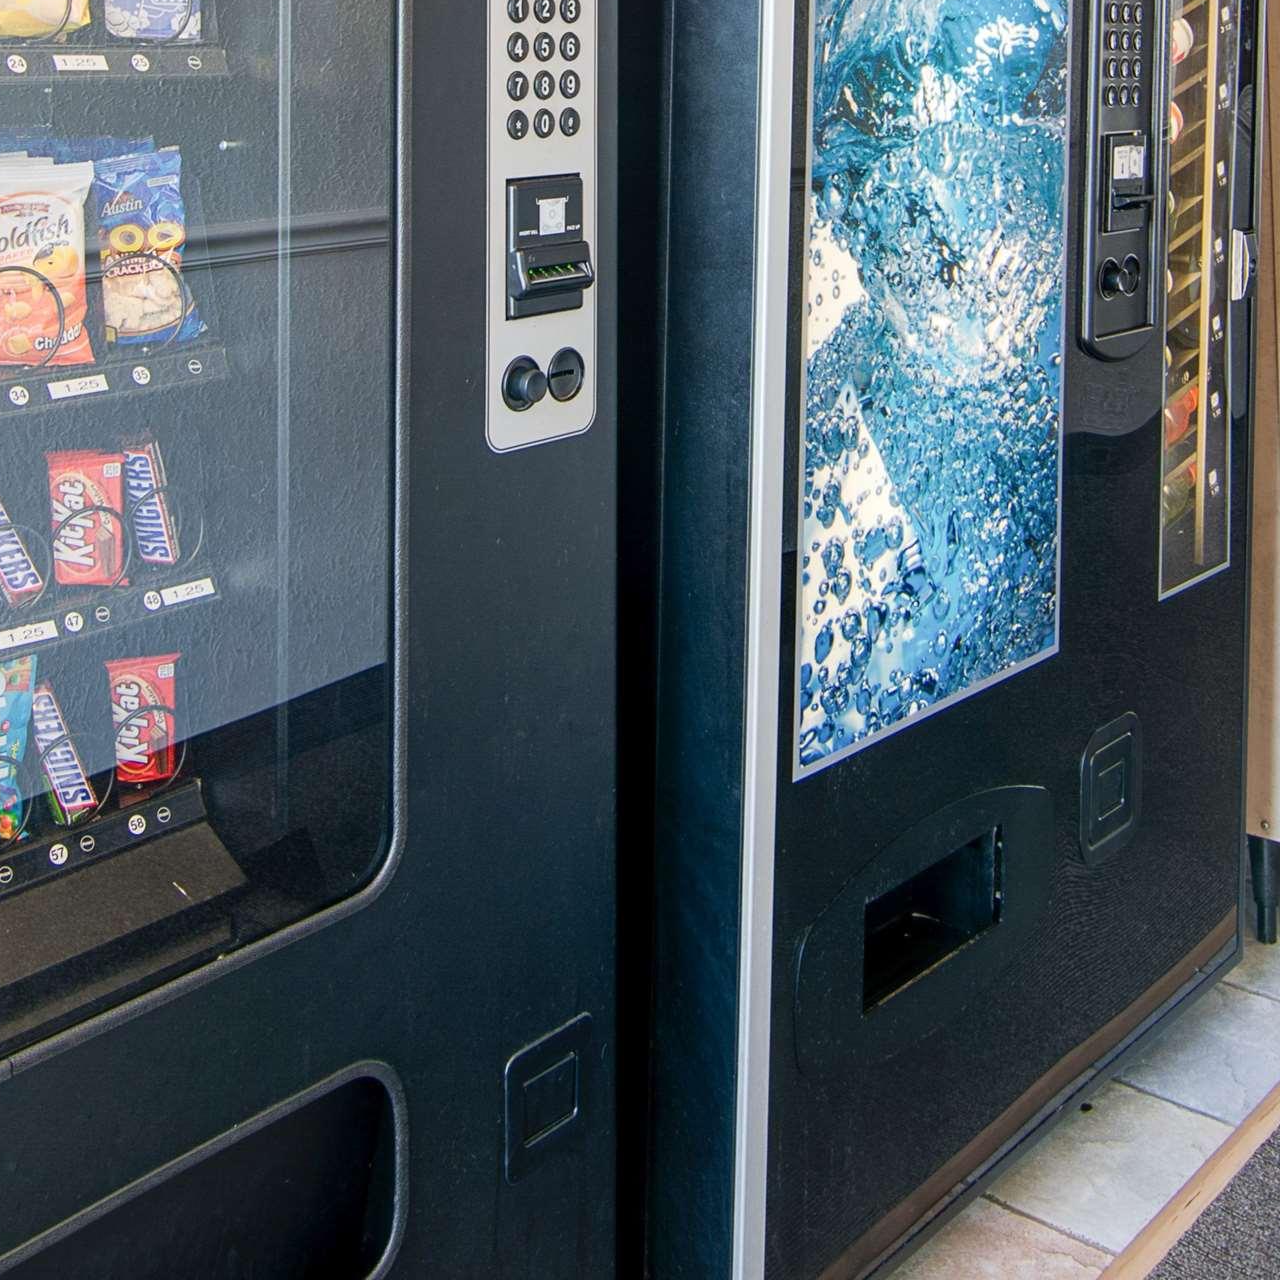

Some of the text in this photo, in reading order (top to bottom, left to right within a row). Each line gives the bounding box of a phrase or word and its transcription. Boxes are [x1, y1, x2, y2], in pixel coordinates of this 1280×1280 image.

[516, 0, 576, 19] 1 2 3
[514, 38, 575, 57] 4 5 6
[10, 58, 25, 70] 24
[133, 57, 148, 68] 25
[515, 76, 575, 96] 7 8 9
[541, 115, 550, 133] 0
[100, 199, 143, 218] Austin
[106, 259, 164, 277] CRACKERS
[134, 370, 148, 381] 35
[11, 390, 27, 401] 34
[125, 455, 171, 558] SNICKERS
[145, 594, 160, 606] 48
[66, 615, 81, 628] 47
[8, 627, 45, 642] 1.25
[33, 694, 91, 803] SNICKERS
[130, 818, 144, 832] 58
[51, 847, 66, 861] 57
